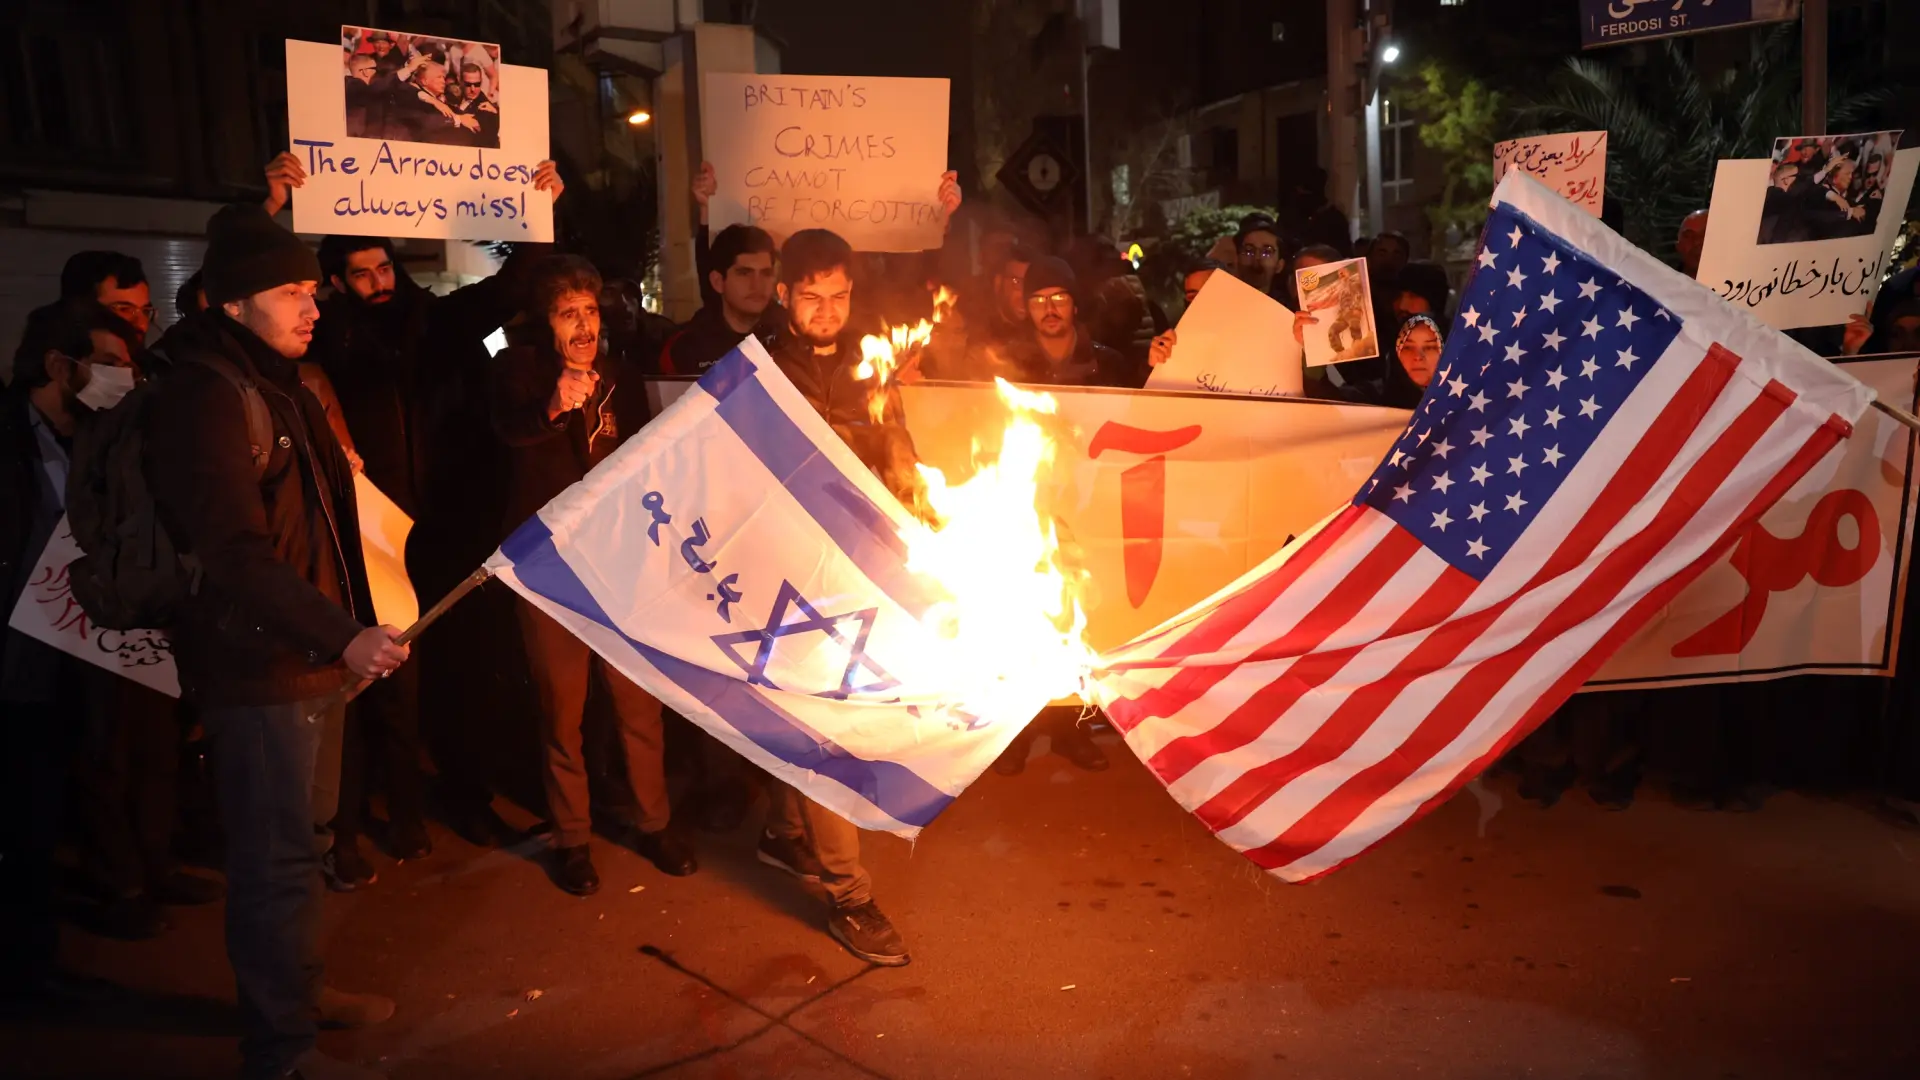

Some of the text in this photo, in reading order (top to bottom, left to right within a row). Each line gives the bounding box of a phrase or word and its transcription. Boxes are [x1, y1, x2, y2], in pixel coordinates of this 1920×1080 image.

[1600, 17, 1662, 37] FERDOSI
[744, 84, 866, 112] BRITAIN'S
[293, 139, 360, 176] The
[370, 141, 463, 177] Arrow
[774, 126, 896, 161] CRIMES
[333, 179, 528, 229] always miss!
[748, 195, 778, 221] BE
[1842, 251, 1884, 295] این
